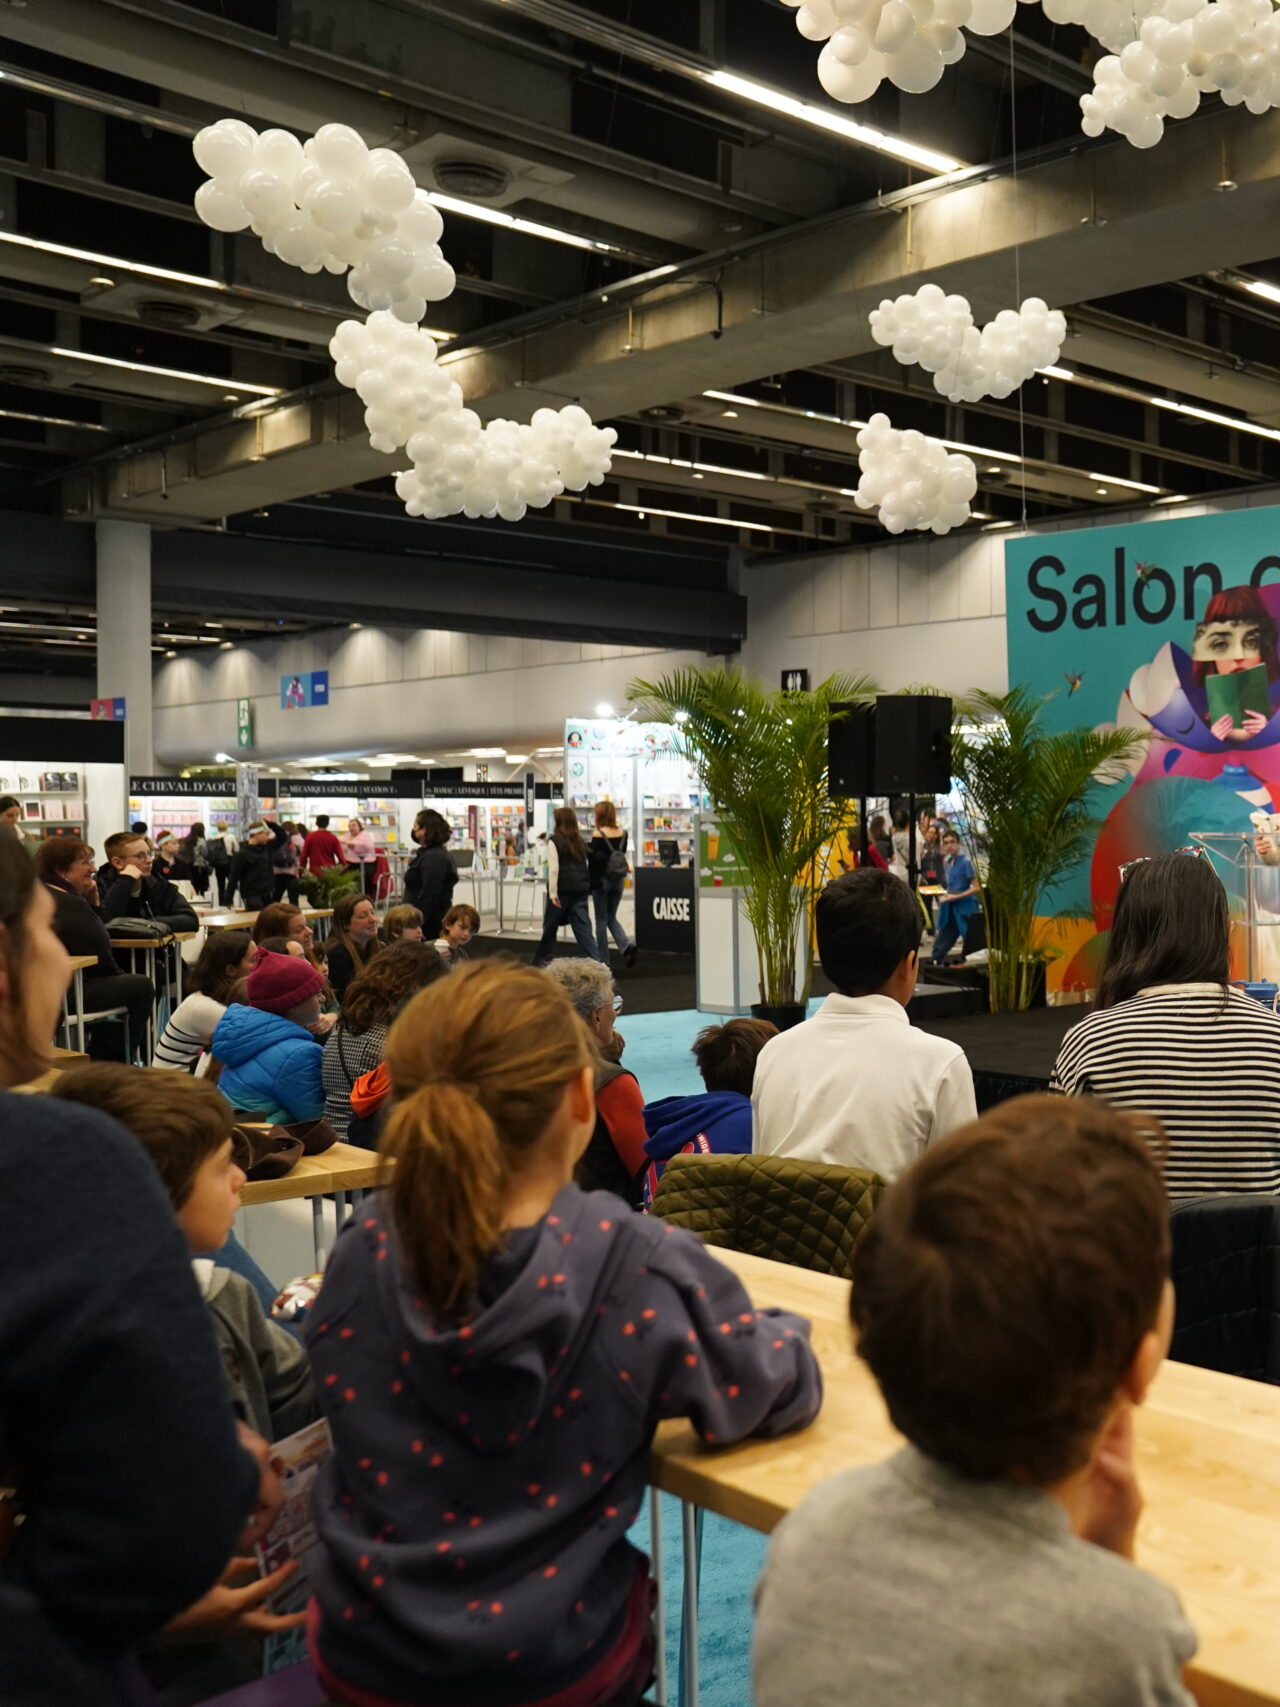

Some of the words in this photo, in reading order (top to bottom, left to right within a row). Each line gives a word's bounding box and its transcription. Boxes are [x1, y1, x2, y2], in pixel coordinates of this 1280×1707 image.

[1024, 545, 1222, 634] Salon
[142, 781, 192, 792] CHEVAL
[653, 897, 690, 921] CAISSE
